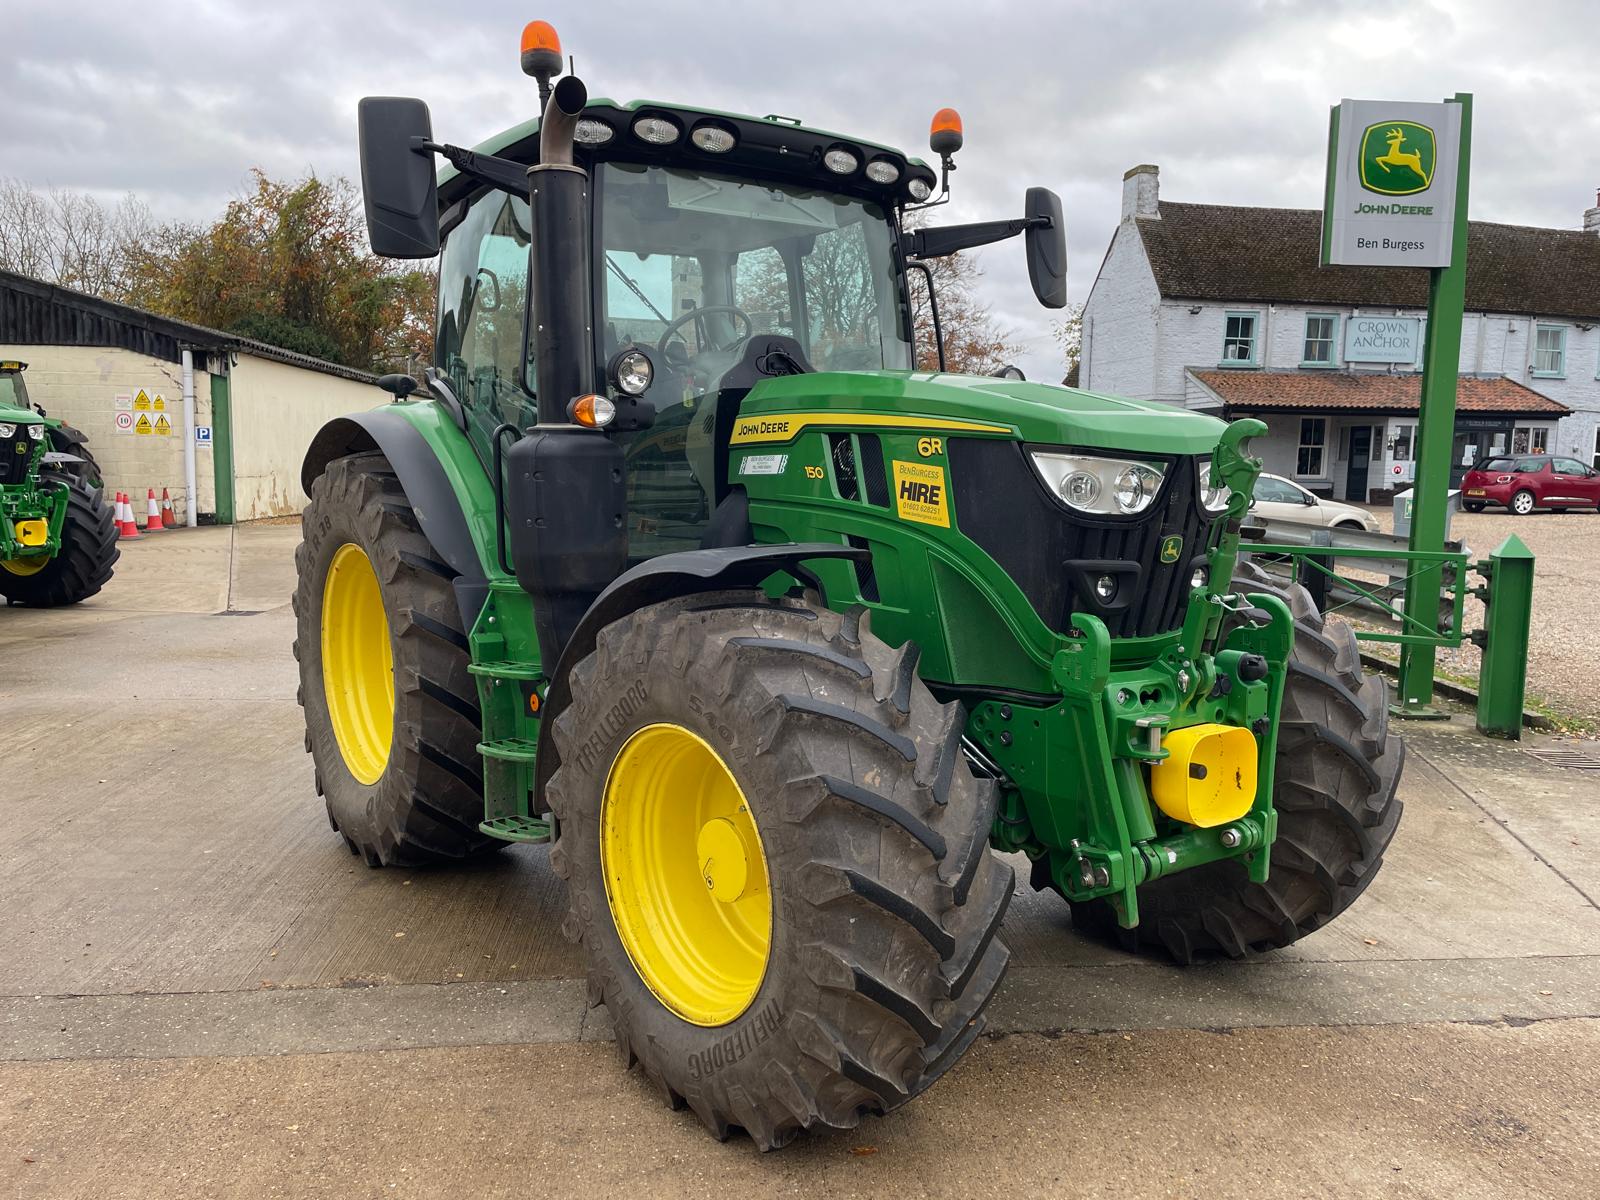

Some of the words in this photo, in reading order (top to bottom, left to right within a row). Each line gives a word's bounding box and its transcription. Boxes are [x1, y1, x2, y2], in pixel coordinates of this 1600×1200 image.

[1354, 202, 1390, 214] JOHN
[1390, 203, 1434, 216] DEERE
[1357, 237, 1378, 249] Ben
[1382, 238, 1425, 252] Burgess
[1358, 321, 1409, 334] CROWN
[1353, 336, 1410, 348] ANCHOR
[738, 423, 760, 436] JOHN
[760, 421, 789, 434] DEERE
[917, 437, 943, 458] 6R
[804, 465, 825, 479] 150
[899, 480, 942, 506] HIRE
[574, 679, 649, 776] TRELLEBORG
[687, 998, 789, 1080] TRELLEBORG
